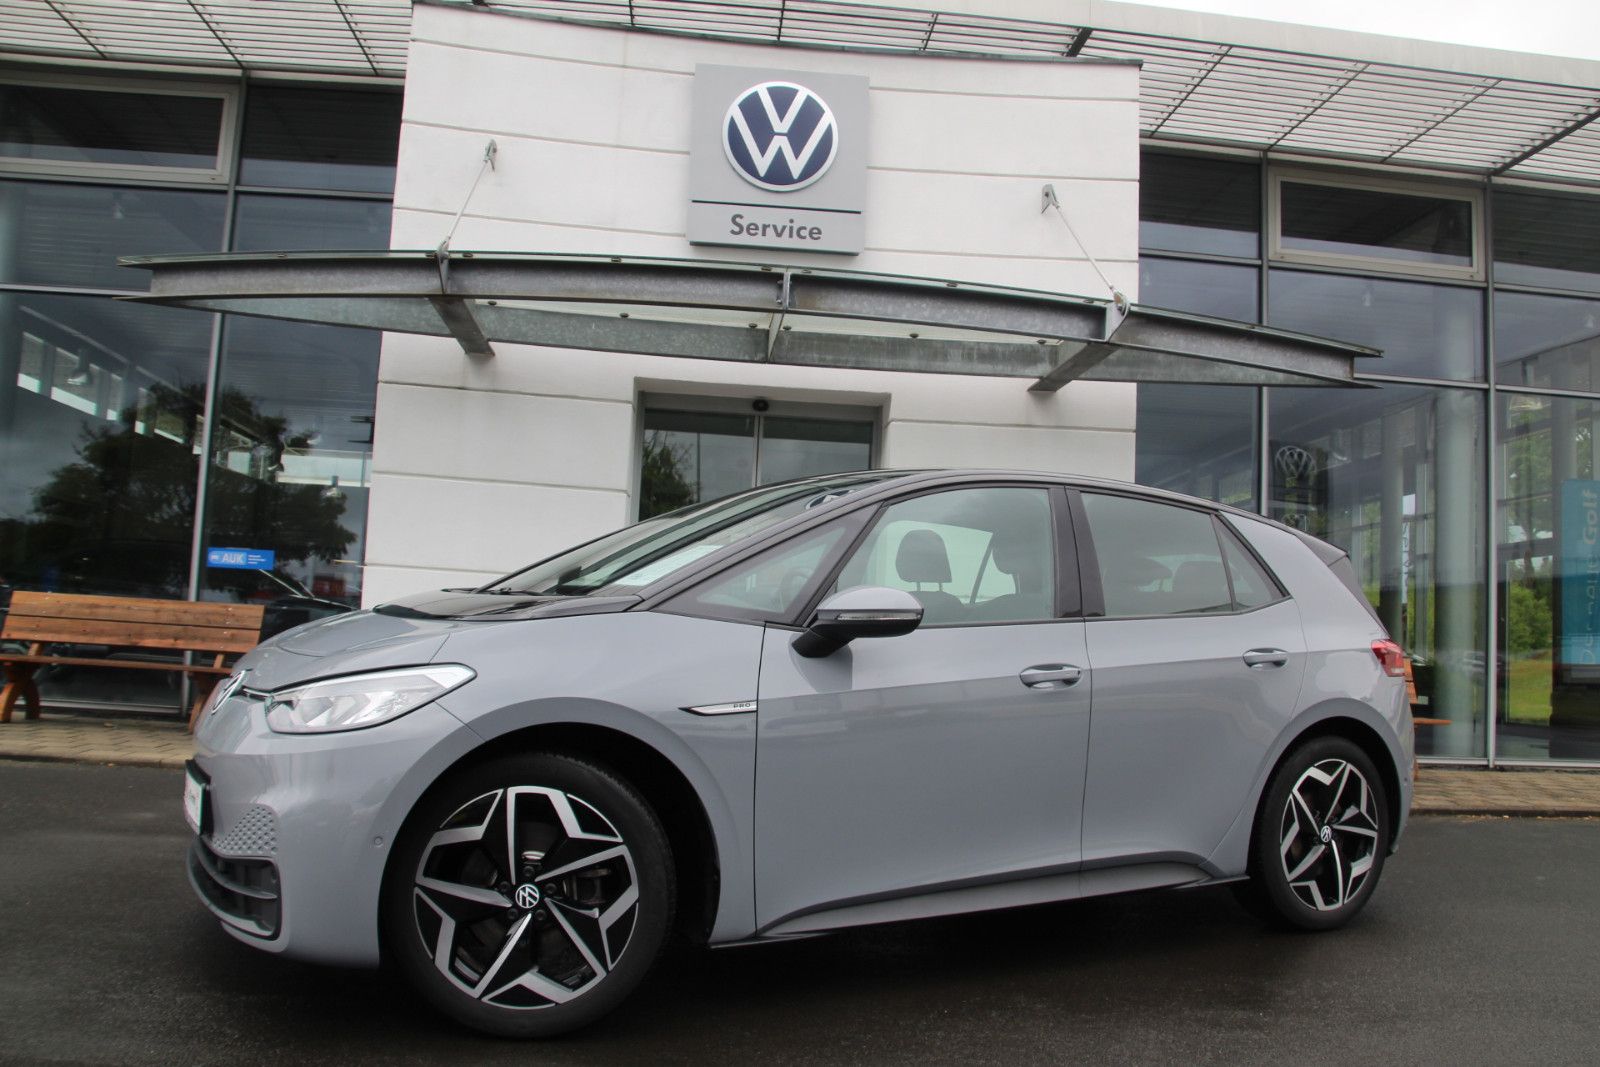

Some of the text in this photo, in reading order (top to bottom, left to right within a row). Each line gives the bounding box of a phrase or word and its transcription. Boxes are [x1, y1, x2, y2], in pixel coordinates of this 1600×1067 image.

[724, 83, 837, 188] VW
[730, 213, 822, 240] Service
[1582, 488, 1598, 544] Golf
